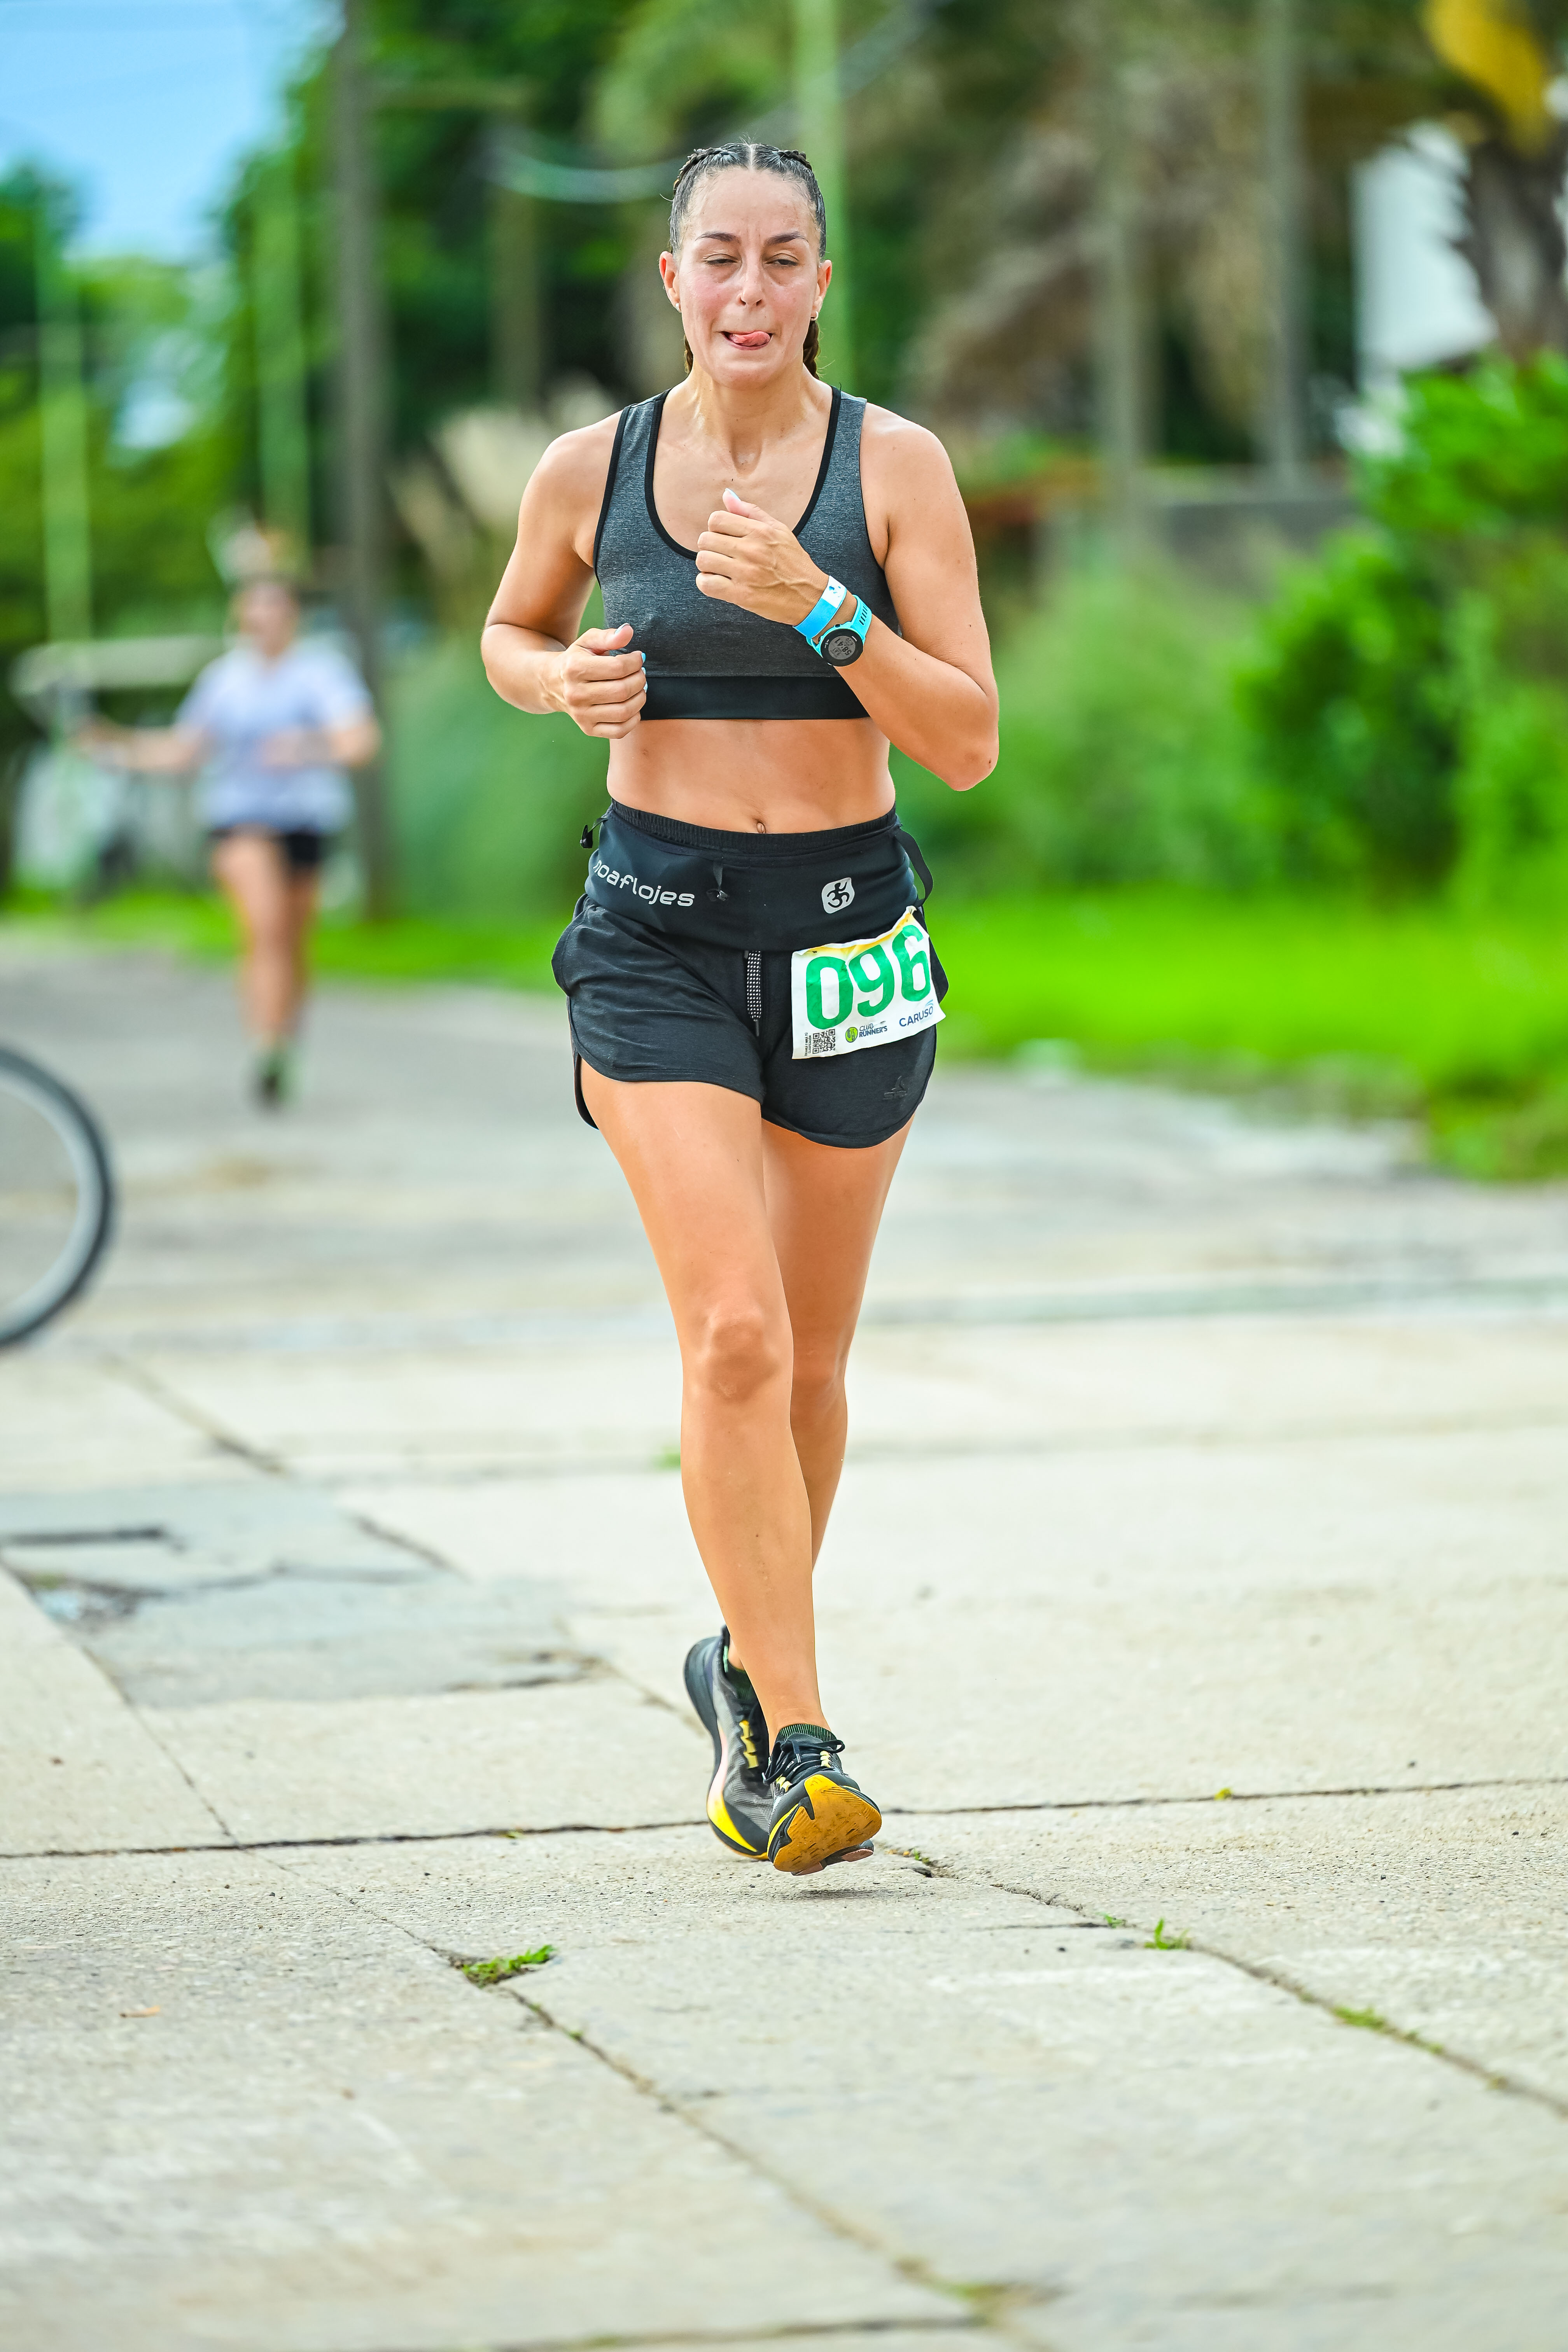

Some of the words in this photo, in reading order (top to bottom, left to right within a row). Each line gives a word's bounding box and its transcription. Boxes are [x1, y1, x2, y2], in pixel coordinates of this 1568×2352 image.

[834, 638, 852, 655] 58:41
[806, 926, 931, 1029] 096
[899, 1006, 933, 1027] CARUSO
[859, 1026, 887, 1037] RUNNER'S
